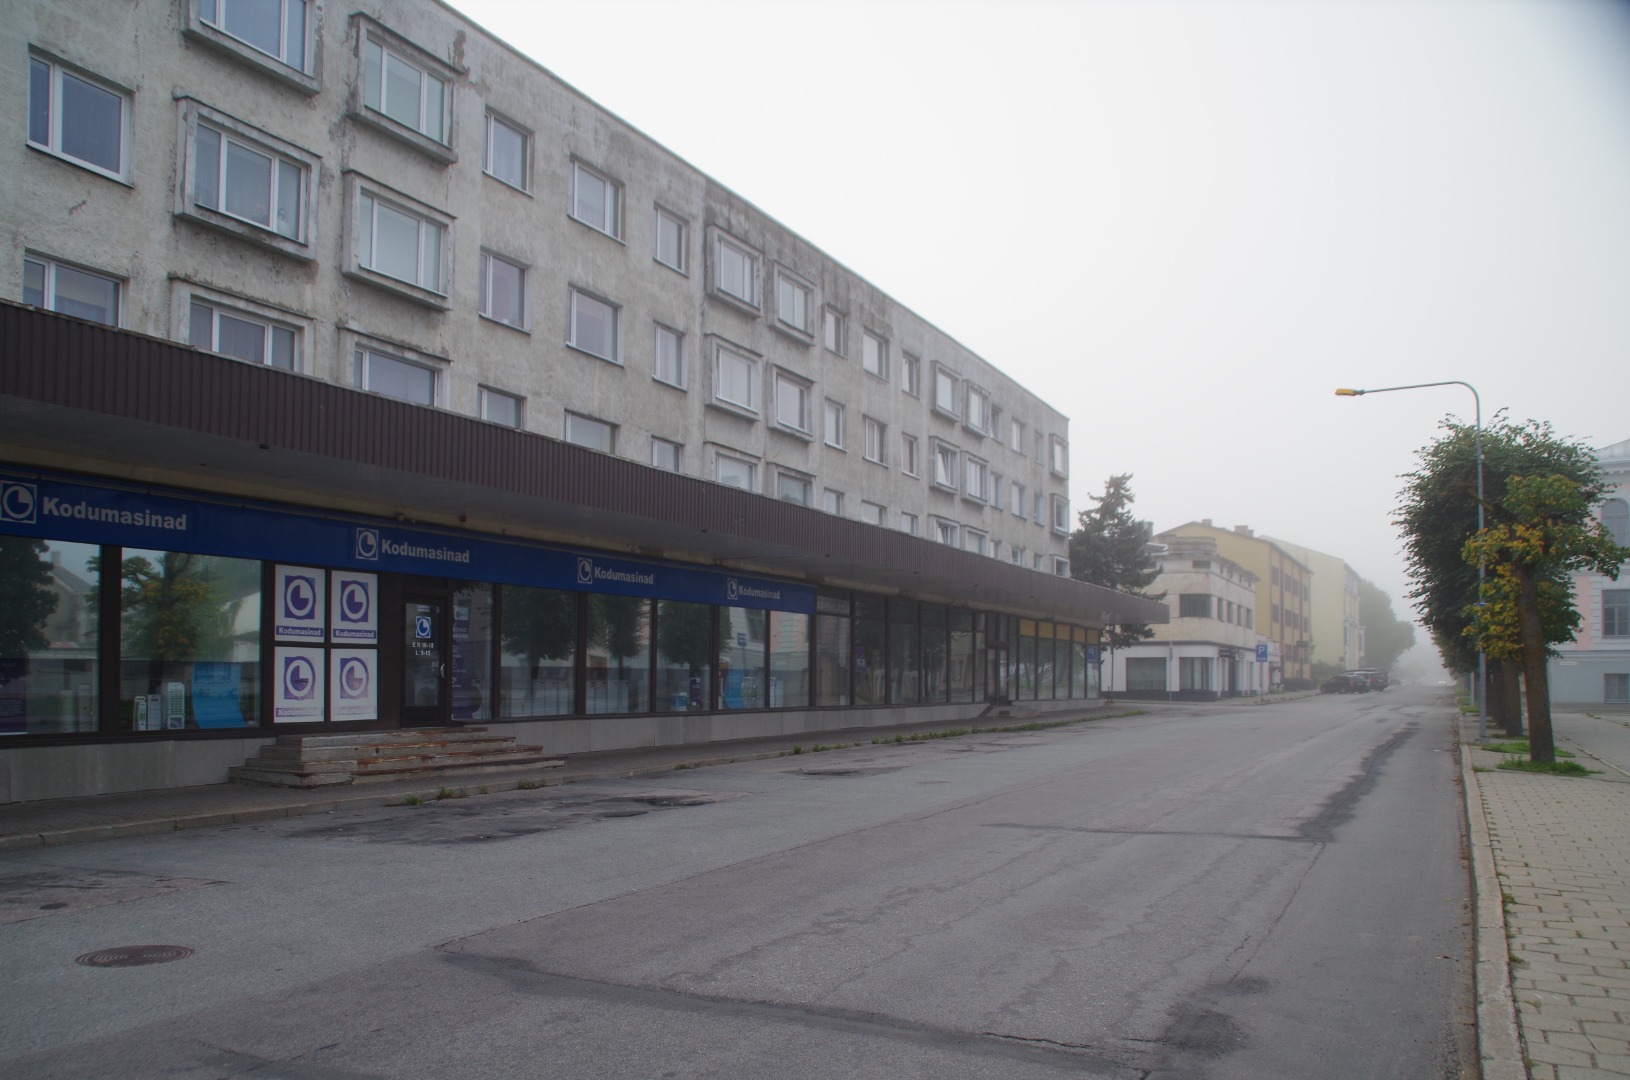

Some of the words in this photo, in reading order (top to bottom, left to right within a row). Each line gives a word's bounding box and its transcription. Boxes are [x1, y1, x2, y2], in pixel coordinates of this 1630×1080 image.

[42, 496, 187, 531] Kodumasinad
[381, 538, 470, 564] Kodumasinad
[594, 566, 654, 584] Kodumasinad
[739, 585, 781, 600] Kodumasinad
[278, 627, 321, 636] Kodumasinad
[335, 629, 375, 638] Kodumasinad
[1258, 645, 1265, 655] P
